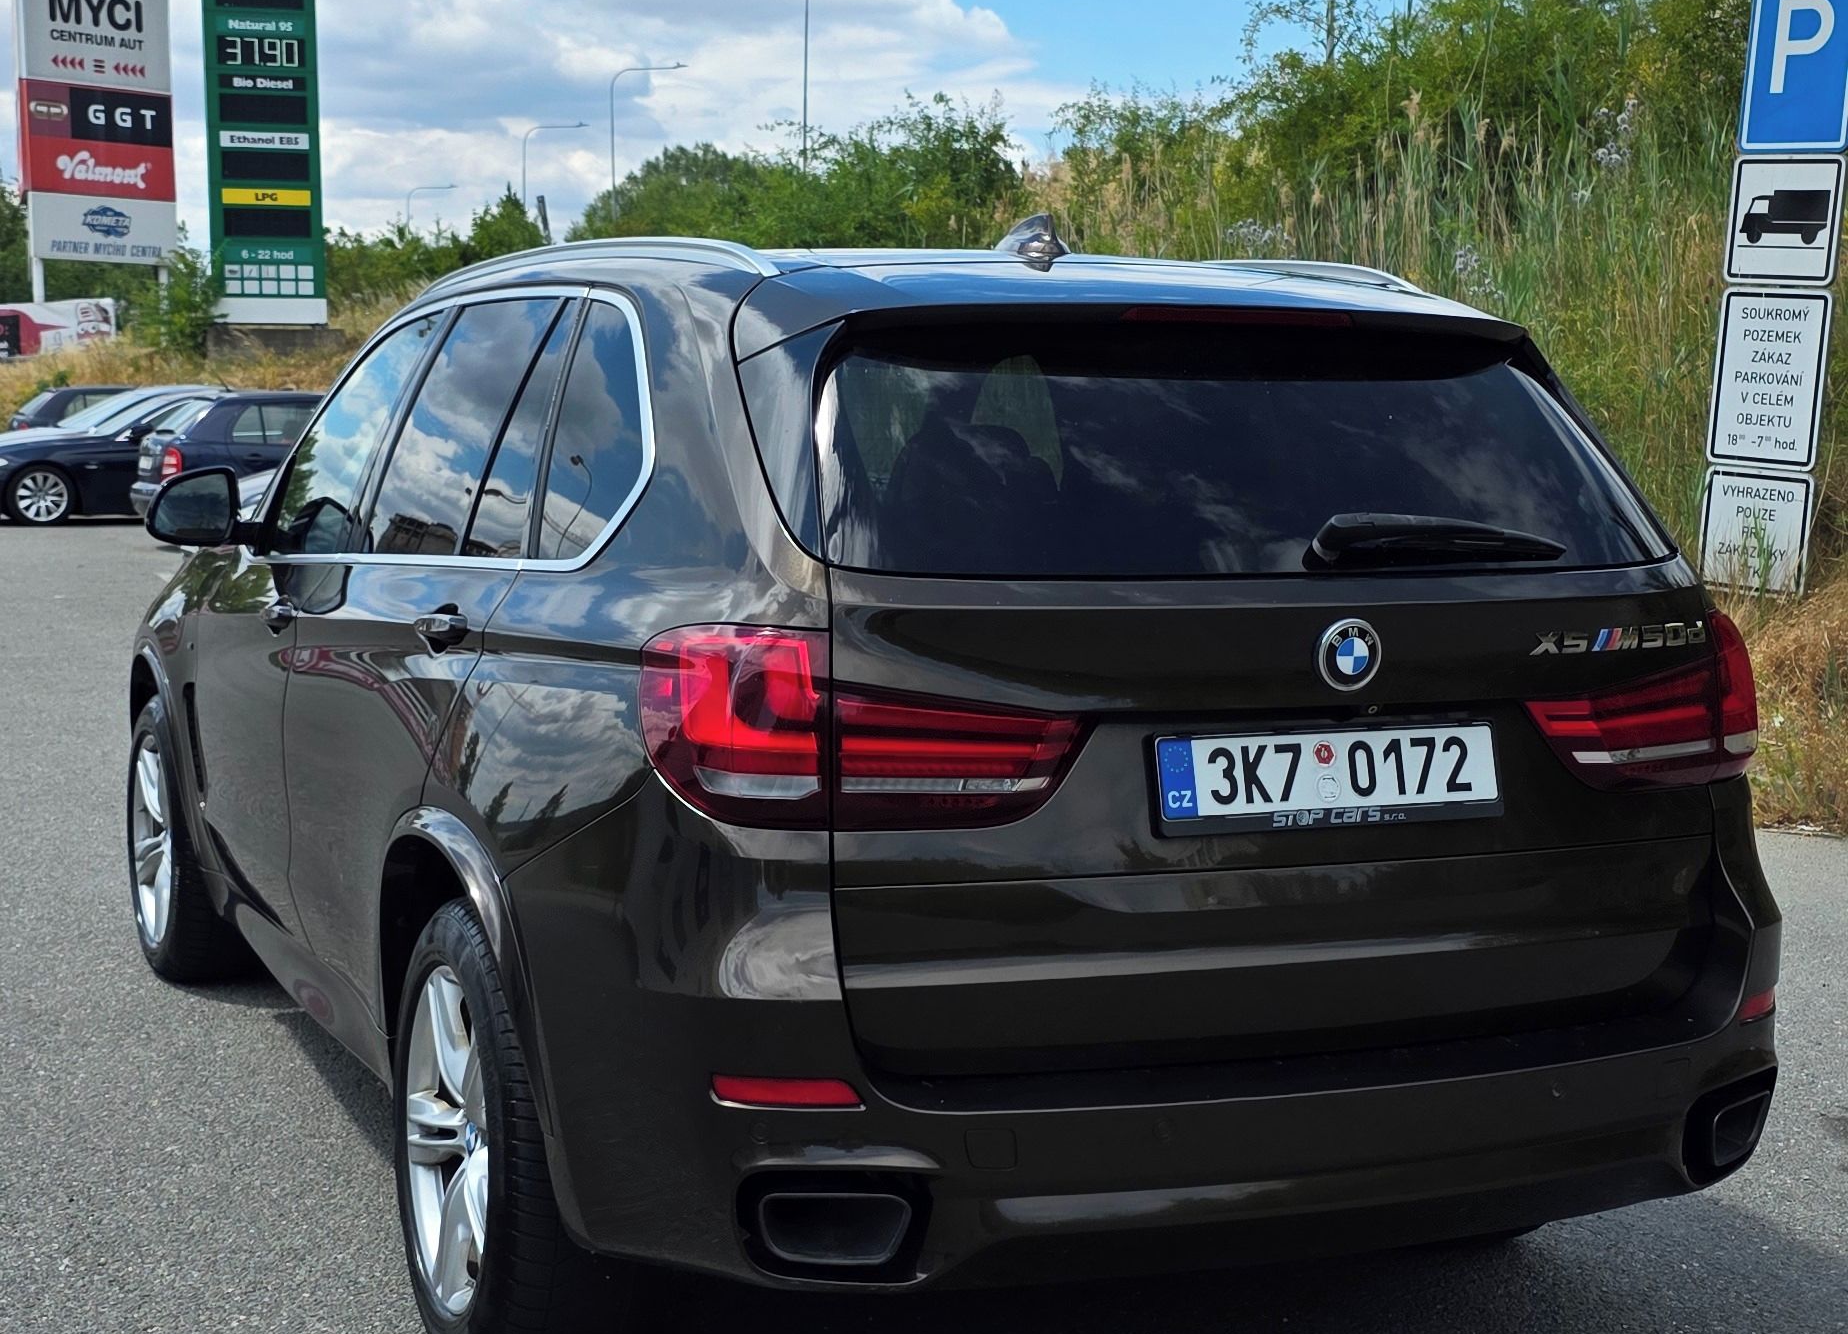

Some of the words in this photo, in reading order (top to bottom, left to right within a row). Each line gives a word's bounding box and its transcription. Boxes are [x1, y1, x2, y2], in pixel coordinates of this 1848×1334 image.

[228, 19, 276, 31] Natural
[278, 21, 294, 32] 95
[50, 28, 116, 48] CENTRUM
[119, 37, 145, 51] AUT
[232, 76, 254, 88] Bio
[256, 77, 294, 90] Diesel
[229, 134, 275, 146] Ethanol
[279, 135, 300, 146] E85
[56, 150, 147, 190] Valmont
[254, 192, 278, 202] LPG
[85, 215, 131, 228] KOMETA
[51, 239, 90, 255] PARTNER
[93, 241, 127, 257] MYCÍHO
[130, 245, 162, 259] CENTRA
[241, 250, 249, 259] 6
[258, 250, 270, 260] 22
[273, 250, 294, 260] hod
[1741, 306, 1810, 322] SOUKROMÝ
[1743, 329, 1802, 344] POZEMEK
[1751, 348, 1792, 365] ZÁKAZ
[1734, 370, 1804, 386] PARKOVÁNÍ
[1740, 391, 1749, 404] V
[1752, 391, 1794, 407] CELÉM
[1736, 412, 1792, 428] OBJEKTU
[1774, 437, 1797, 451] hod.
[1722, 485, 1795, 503] VYHRAZENO
[1736, 506, 1776, 522] POUZE
[1331, 627, 1374, 647] BMW
[1167, 790, 1193, 809] CZ
[1207, 743, 1302, 805] 3K7
[1347, 736, 1473, 797] 0172
